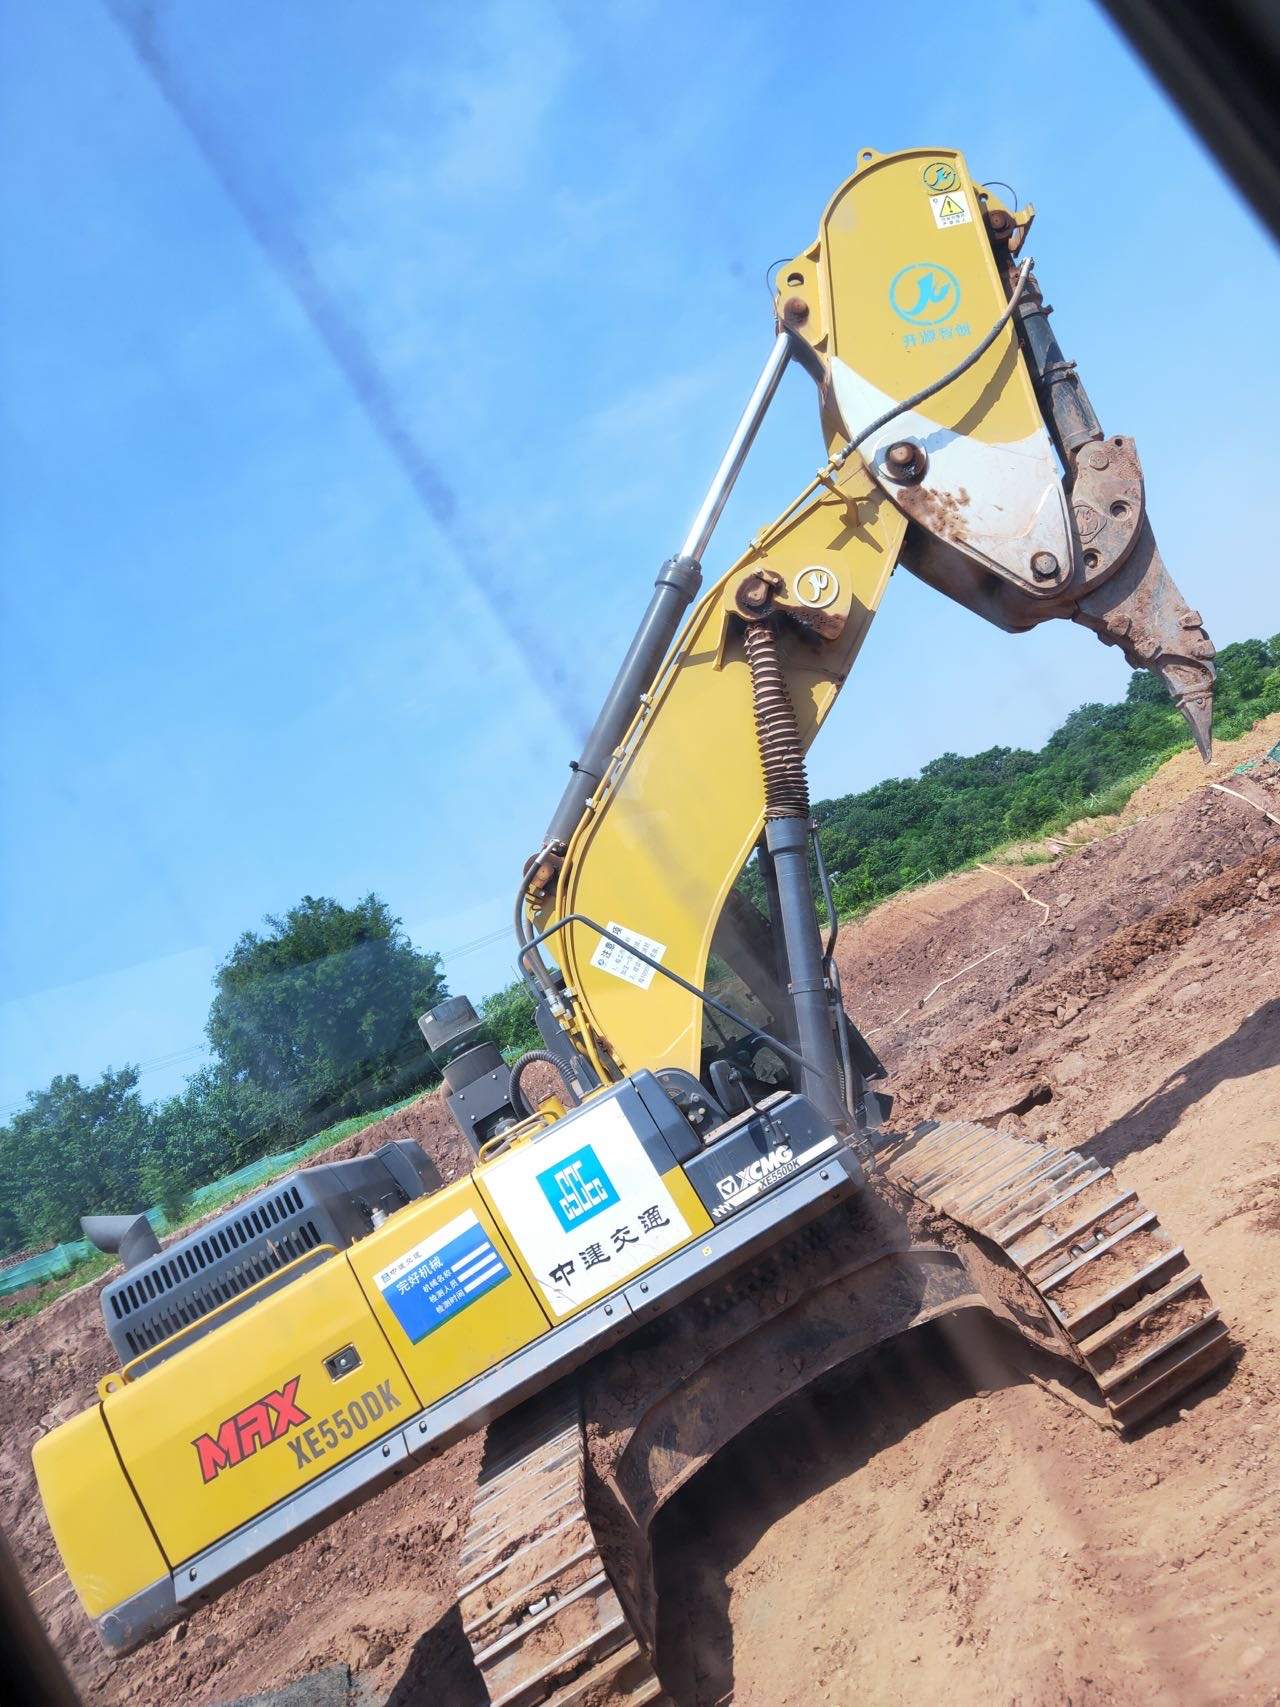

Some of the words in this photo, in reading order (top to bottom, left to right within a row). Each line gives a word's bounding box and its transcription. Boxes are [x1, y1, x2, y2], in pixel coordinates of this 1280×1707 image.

[601, 926, 623, 959] 注意项
[736, 1144, 793, 1190] XCMG
[759, 1159, 800, 1190] XE550DK
[548, 1205, 671, 1287] 中建交通
[396, 1256, 443, 1295] 完好机械
[422, 1269, 452, 1293] 机械名称
[429, 1279, 458, 1303] 检测人员
[436, 1289, 465, 1313] 检测时间
[190, 1374, 311, 1485] MAX
[287, 1379, 401, 1469] XE550DK
